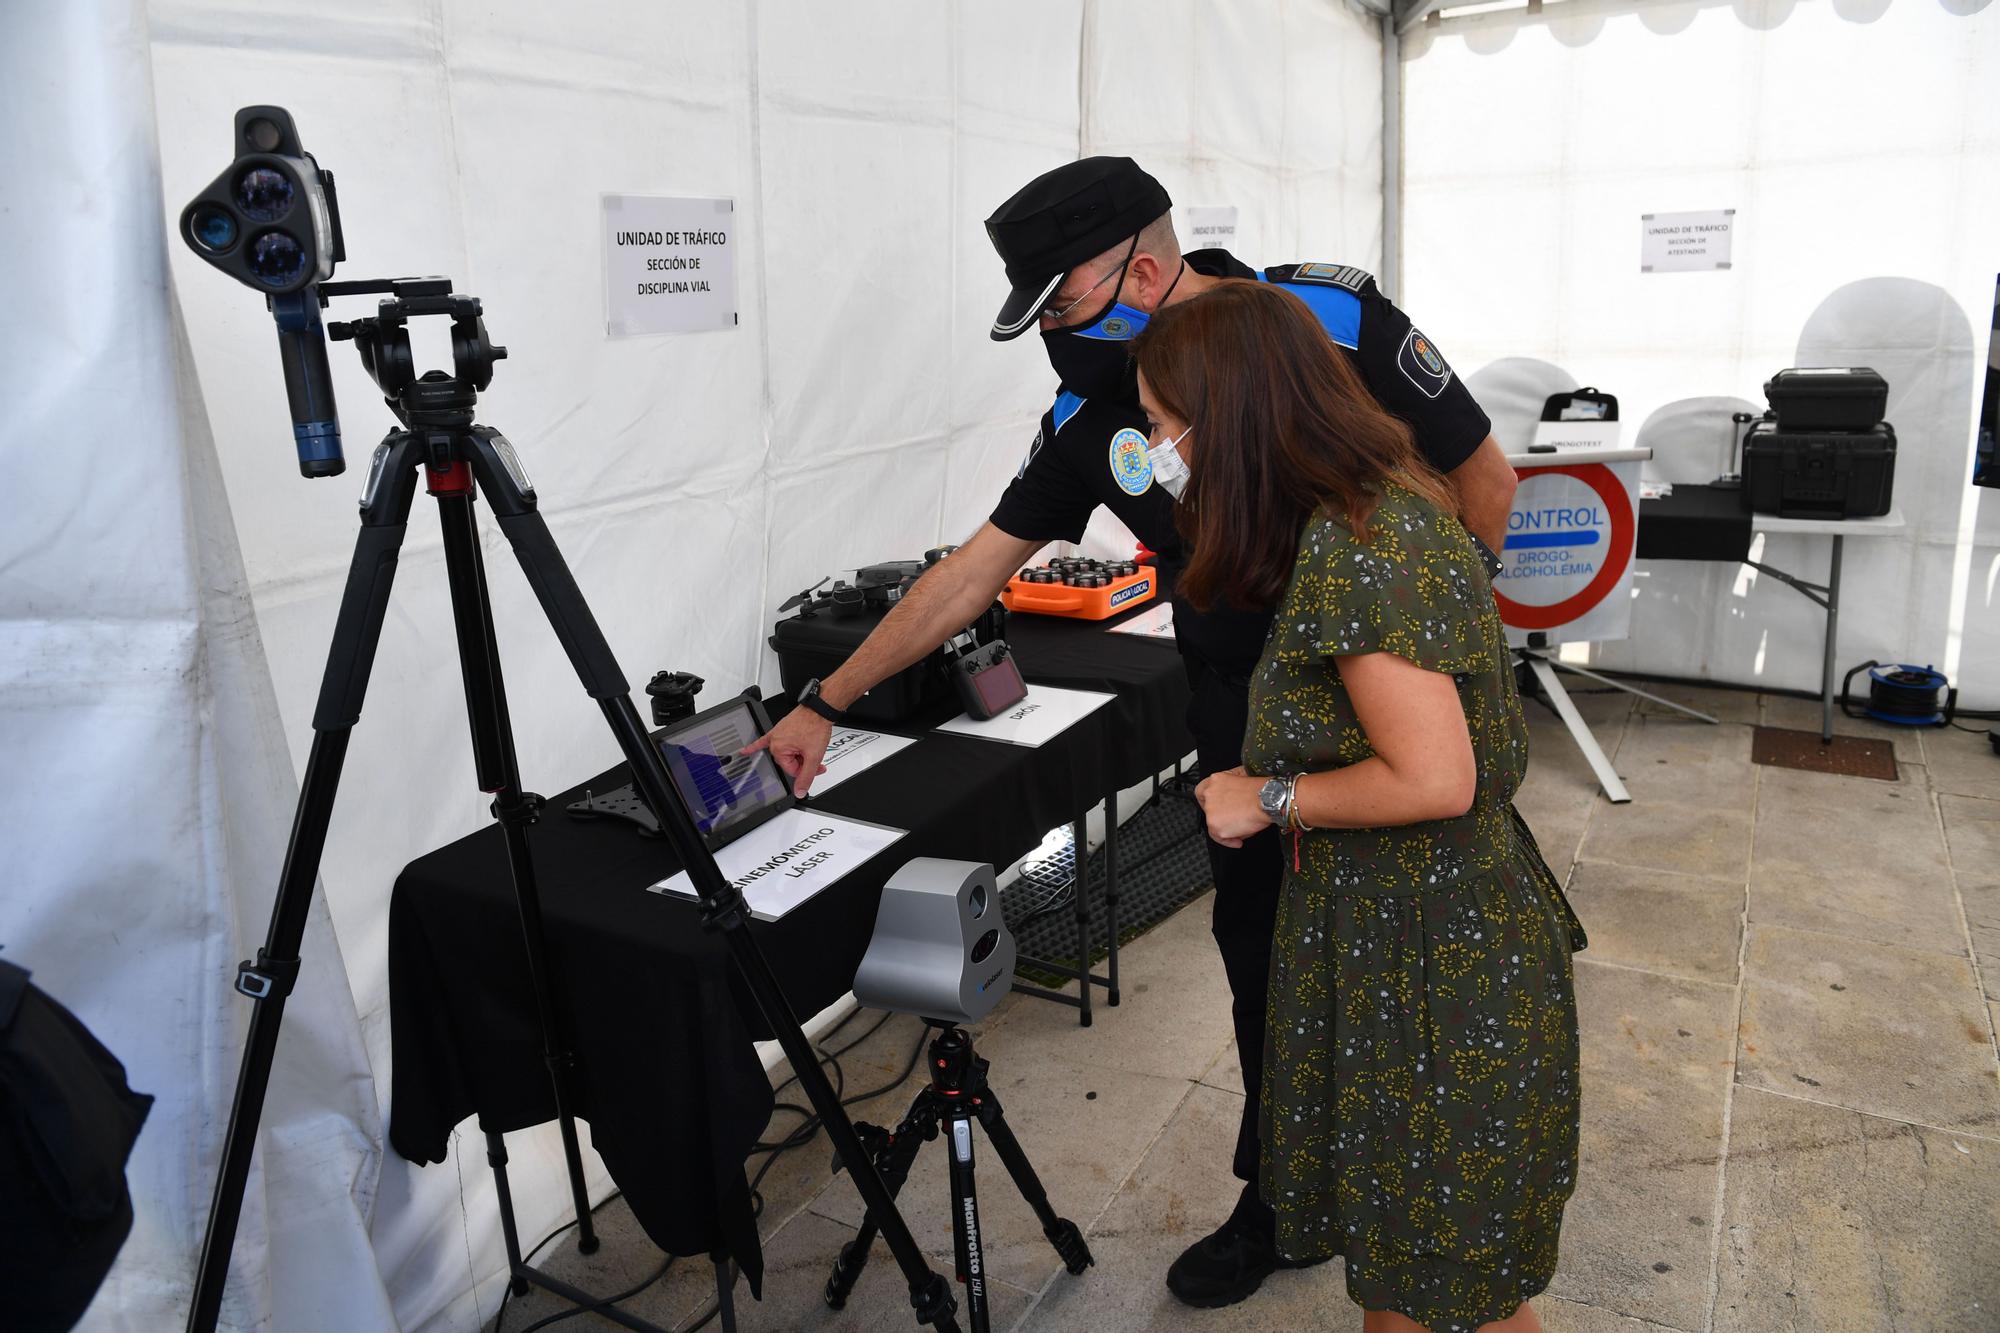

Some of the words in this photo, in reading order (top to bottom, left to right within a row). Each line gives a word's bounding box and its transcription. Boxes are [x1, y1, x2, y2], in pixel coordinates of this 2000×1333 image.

[617, 231, 663, 246] UNIDAD
[666, 231, 680, 246] DE
[683, 228, 726, 246] TRÁFICO
[1649, 227, 1680, 235] UNIDAD
[647, 255, 687, 271] SECCIÓN
[689, 257, 701, 270] DE
[638, 281, 689, 295] DISCIPLINA
[691, 280, 711, 292] VIAL
[1508, 507, 1604, 530] ONTROL
[1518, 550, 1574, 564] DROGO-
[733, 827, 835, 887] INEMÓMETRO
[784, 851, 834, 878] LÁSER
[963, 1196, 980, 1275] Manfrotto
[972, 1278, 983, 1297] 190
